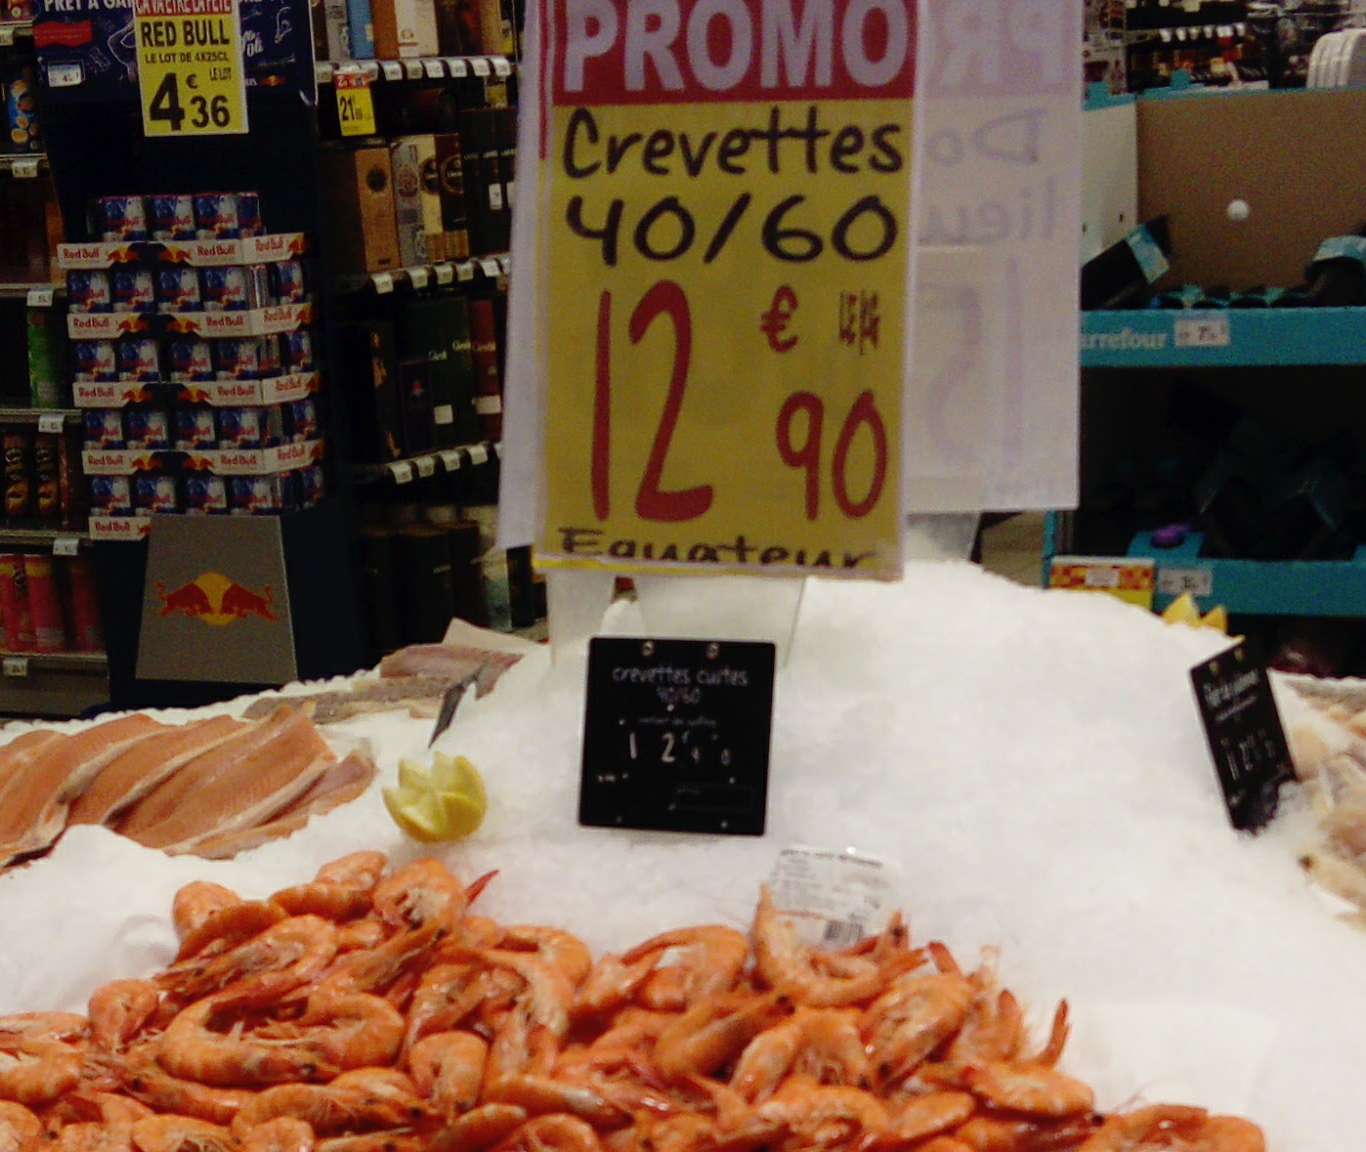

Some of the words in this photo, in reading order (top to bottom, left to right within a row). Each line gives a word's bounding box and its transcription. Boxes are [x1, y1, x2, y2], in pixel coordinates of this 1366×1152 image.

[141, 20, 176, 48] RED
[185, 19, 230, 45] BULL
[145, 53, 156, 64] LE
[158, 53, 176, 64] LOT
[180, 53, 192, 63] DE
[563, 0, 908, 93] PROMO
[149, 72, 185, 131] 4
[186, 74, 198, 89] €
[190, 95, 230, 128] 36
[340, 97, 355, 121] 21
[563, 105, 904, 179] Crevettes
[566, 193, 898, 266] 40/60
[760, 284, 798, 353] €
[592, 280, 713, 521] 12
[775, 389, 887, 521] 90
